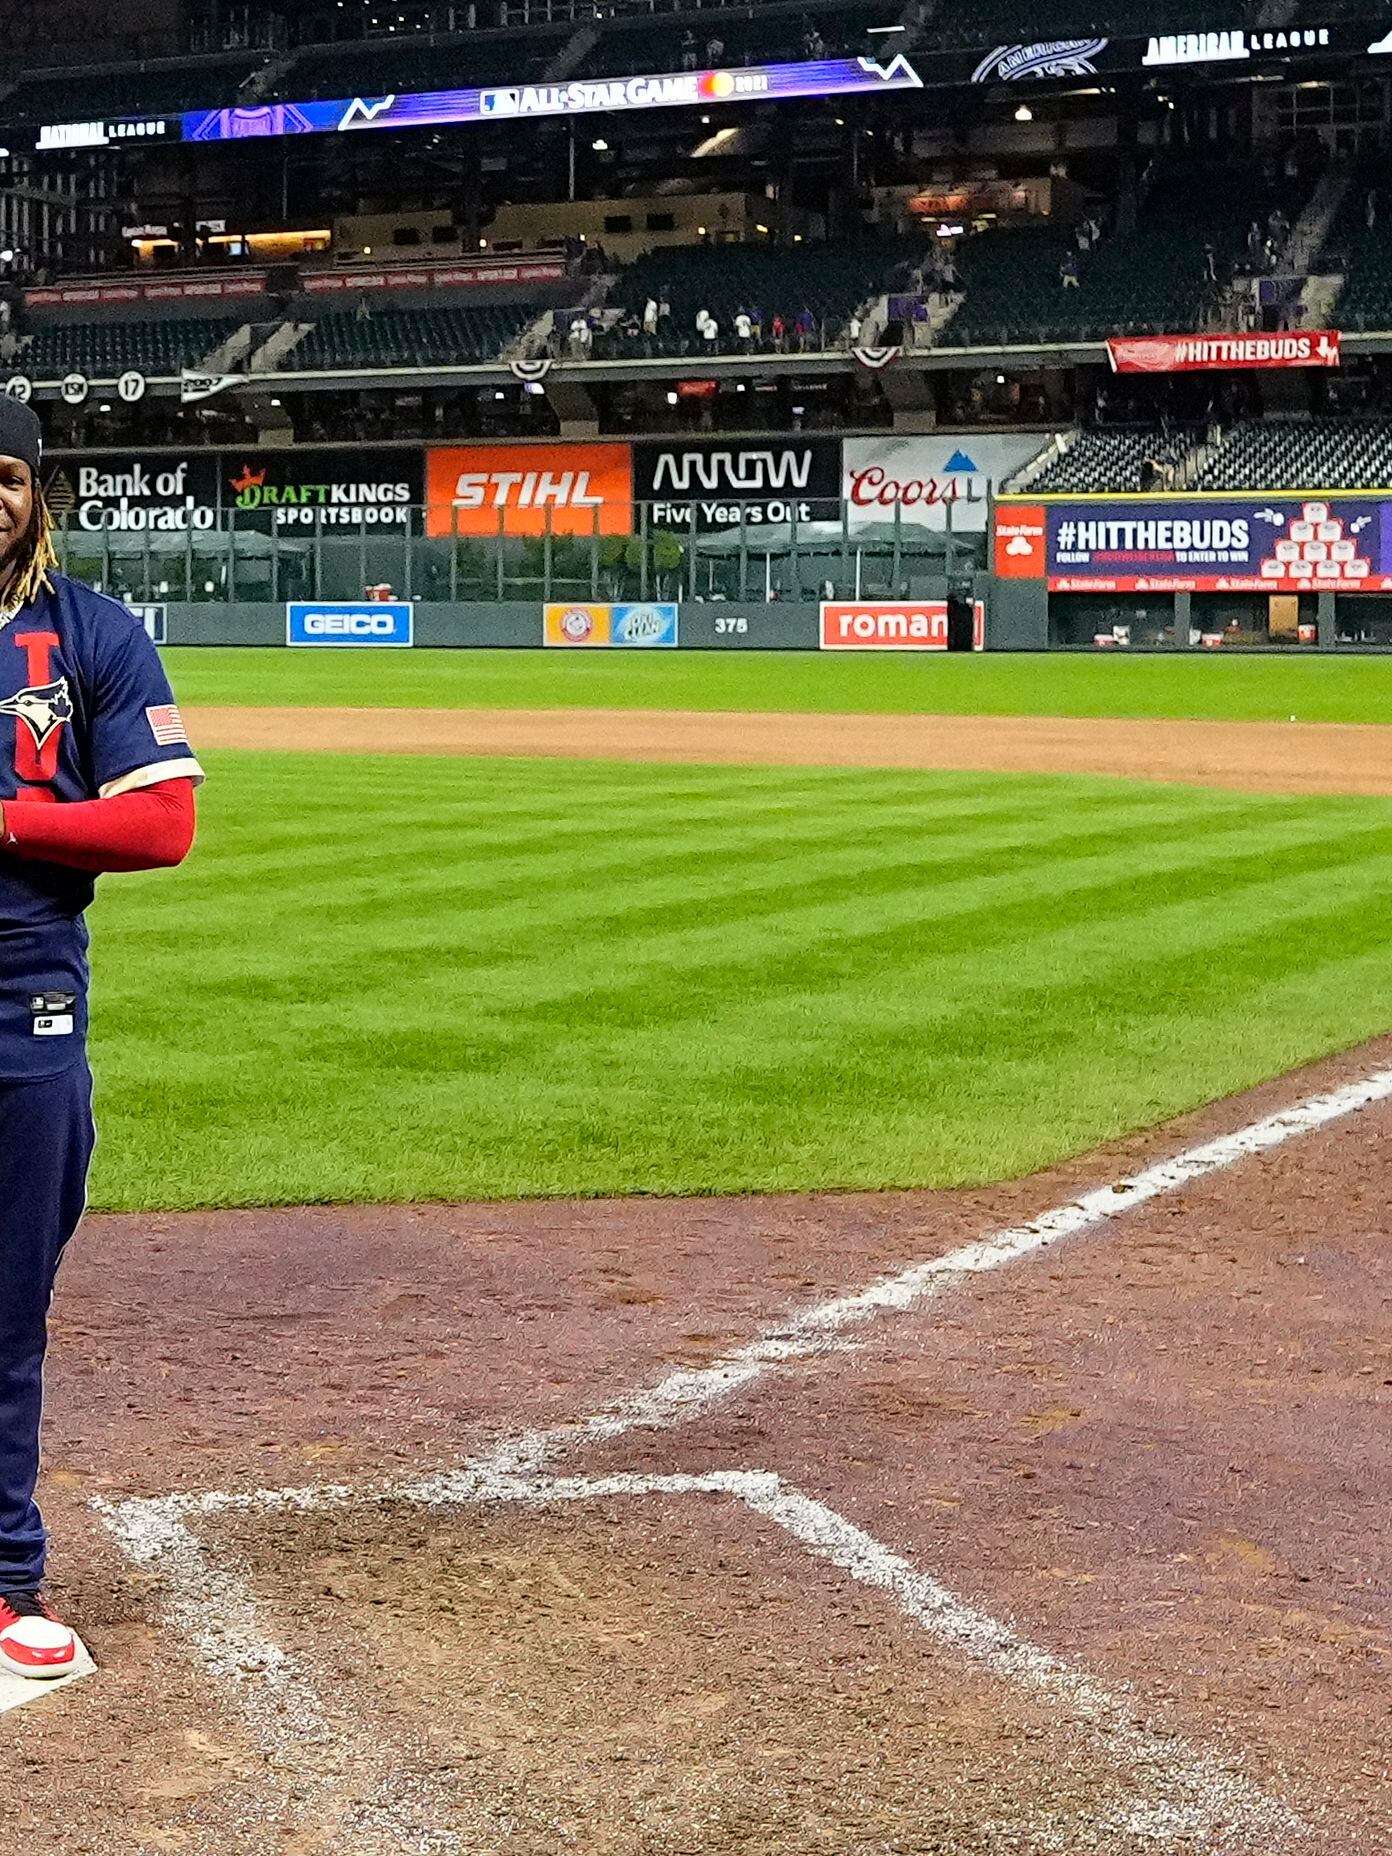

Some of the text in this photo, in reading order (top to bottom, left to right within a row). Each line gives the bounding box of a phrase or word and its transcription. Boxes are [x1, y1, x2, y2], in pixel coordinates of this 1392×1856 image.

[1143, 29, 1329, 65] AMERICAN LEAGUE
[109, 121, 165, 137] LEAGUE
[1175, 337, 1311, 363] #HITTHEBUDS
[123, 378, 140, 397] 17
[79, 462, 187, 498] Bank of
[452, 471, 604, 509] STIHL
[849, 466, 959, 506] Coors
[235, 483, 411, 509] DRAFTKINGS
[78, 496, 214, 531] Colorado
[276, 507, 408, 525] SPORTSBOOK
[1057, 519, 1250, 550] #HITTHEBUDS
[1056, 551, 1090, 563] FOLLOW
[1176, 551, 1187, 563] TO
[1189, 551, 1216, 563] ENTER
[1218, 551, 1230, 563] TO
[1231, 550, 1249, 562] WIN
[304, 614, 395, 635] GEICO
[715, 617, 748, 633] 375
[839, 613, 948, 638] roman
